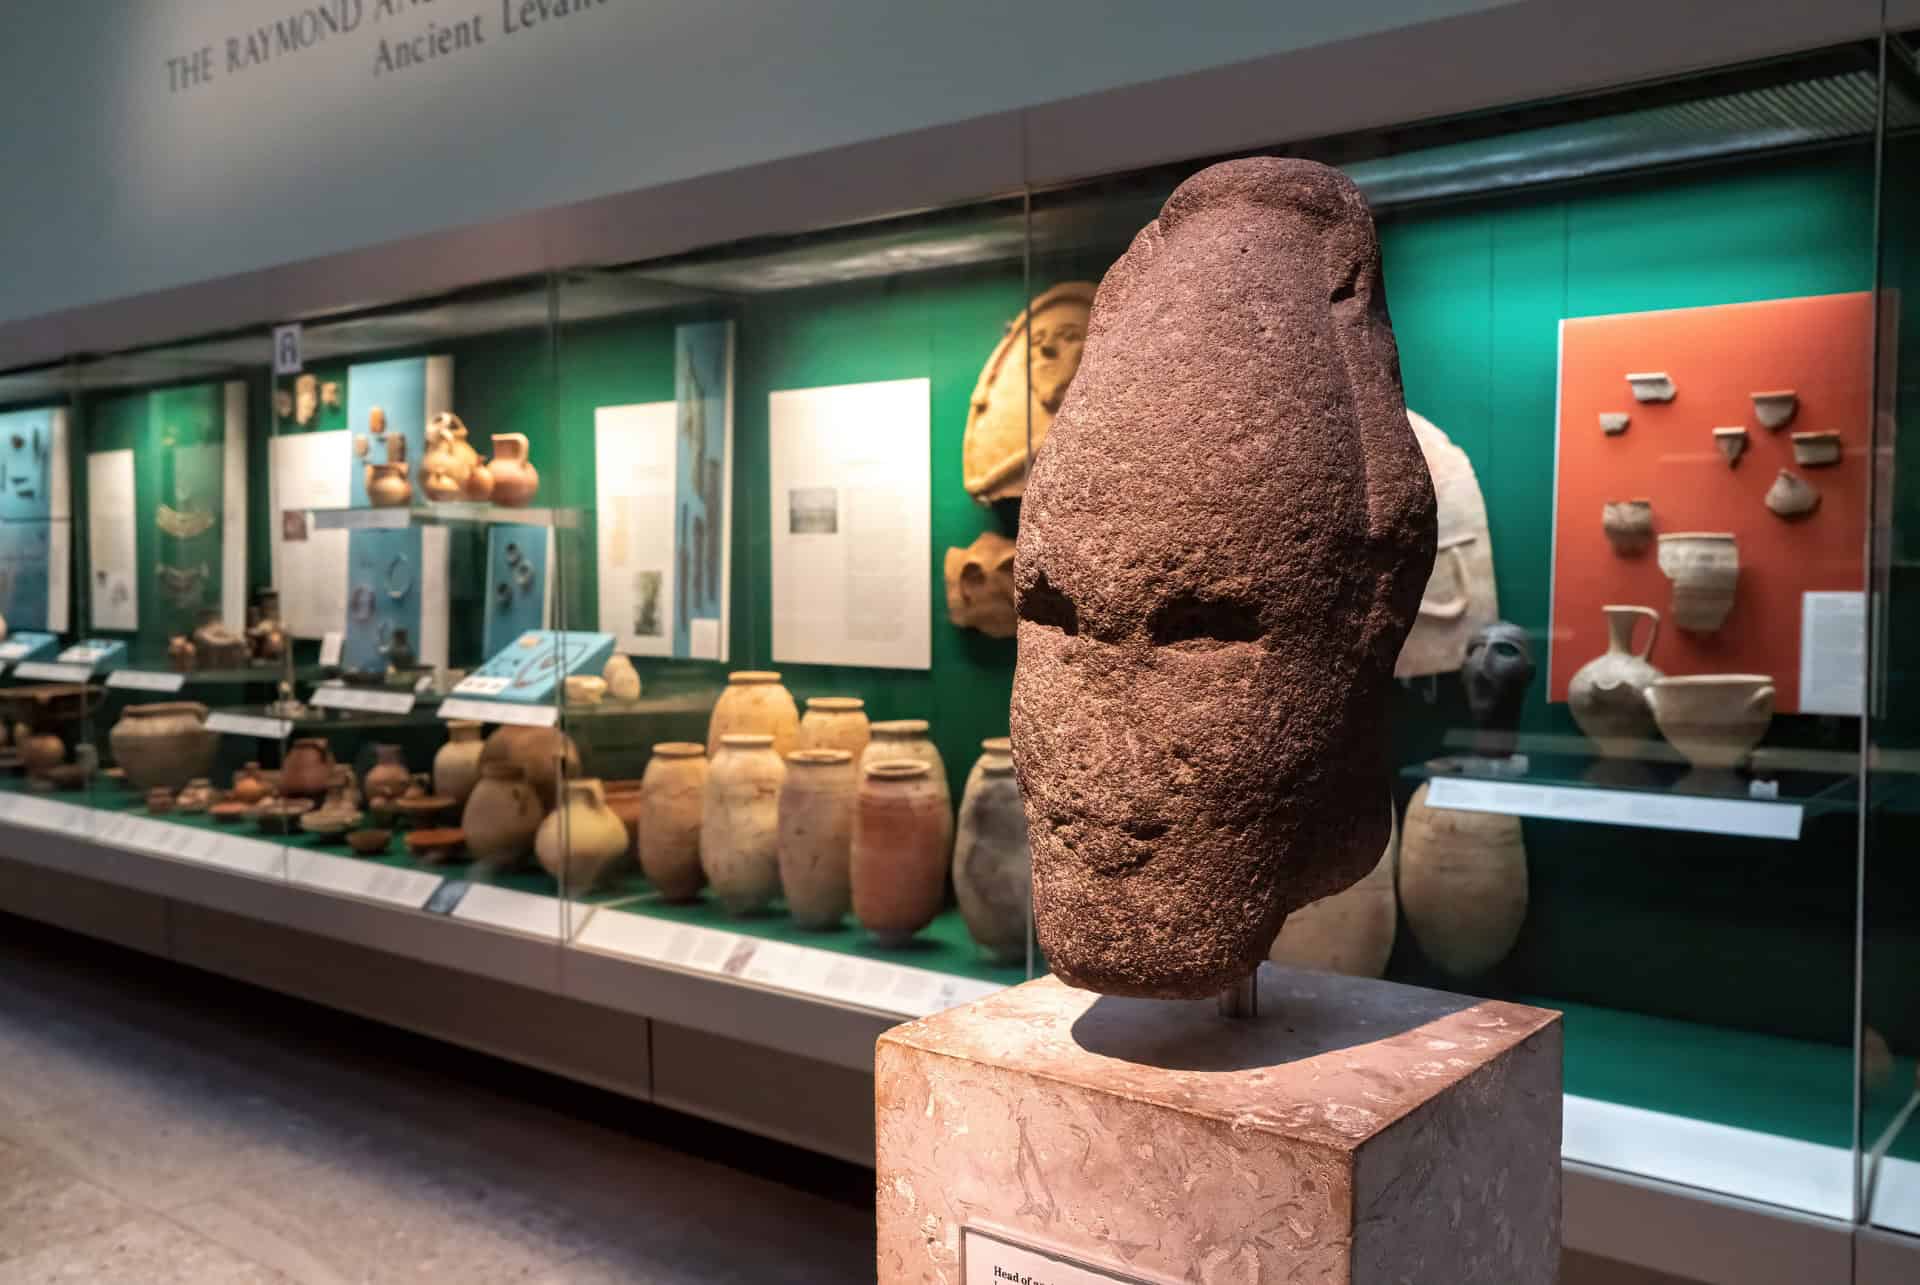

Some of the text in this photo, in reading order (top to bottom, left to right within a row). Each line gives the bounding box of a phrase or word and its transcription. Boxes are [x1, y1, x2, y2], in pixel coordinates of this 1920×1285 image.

[164, 0, 363, 94] THE RAYMOND
[372, 14, 485, 78] Ancient
[994, 1265, 1032, 1285] Head of
